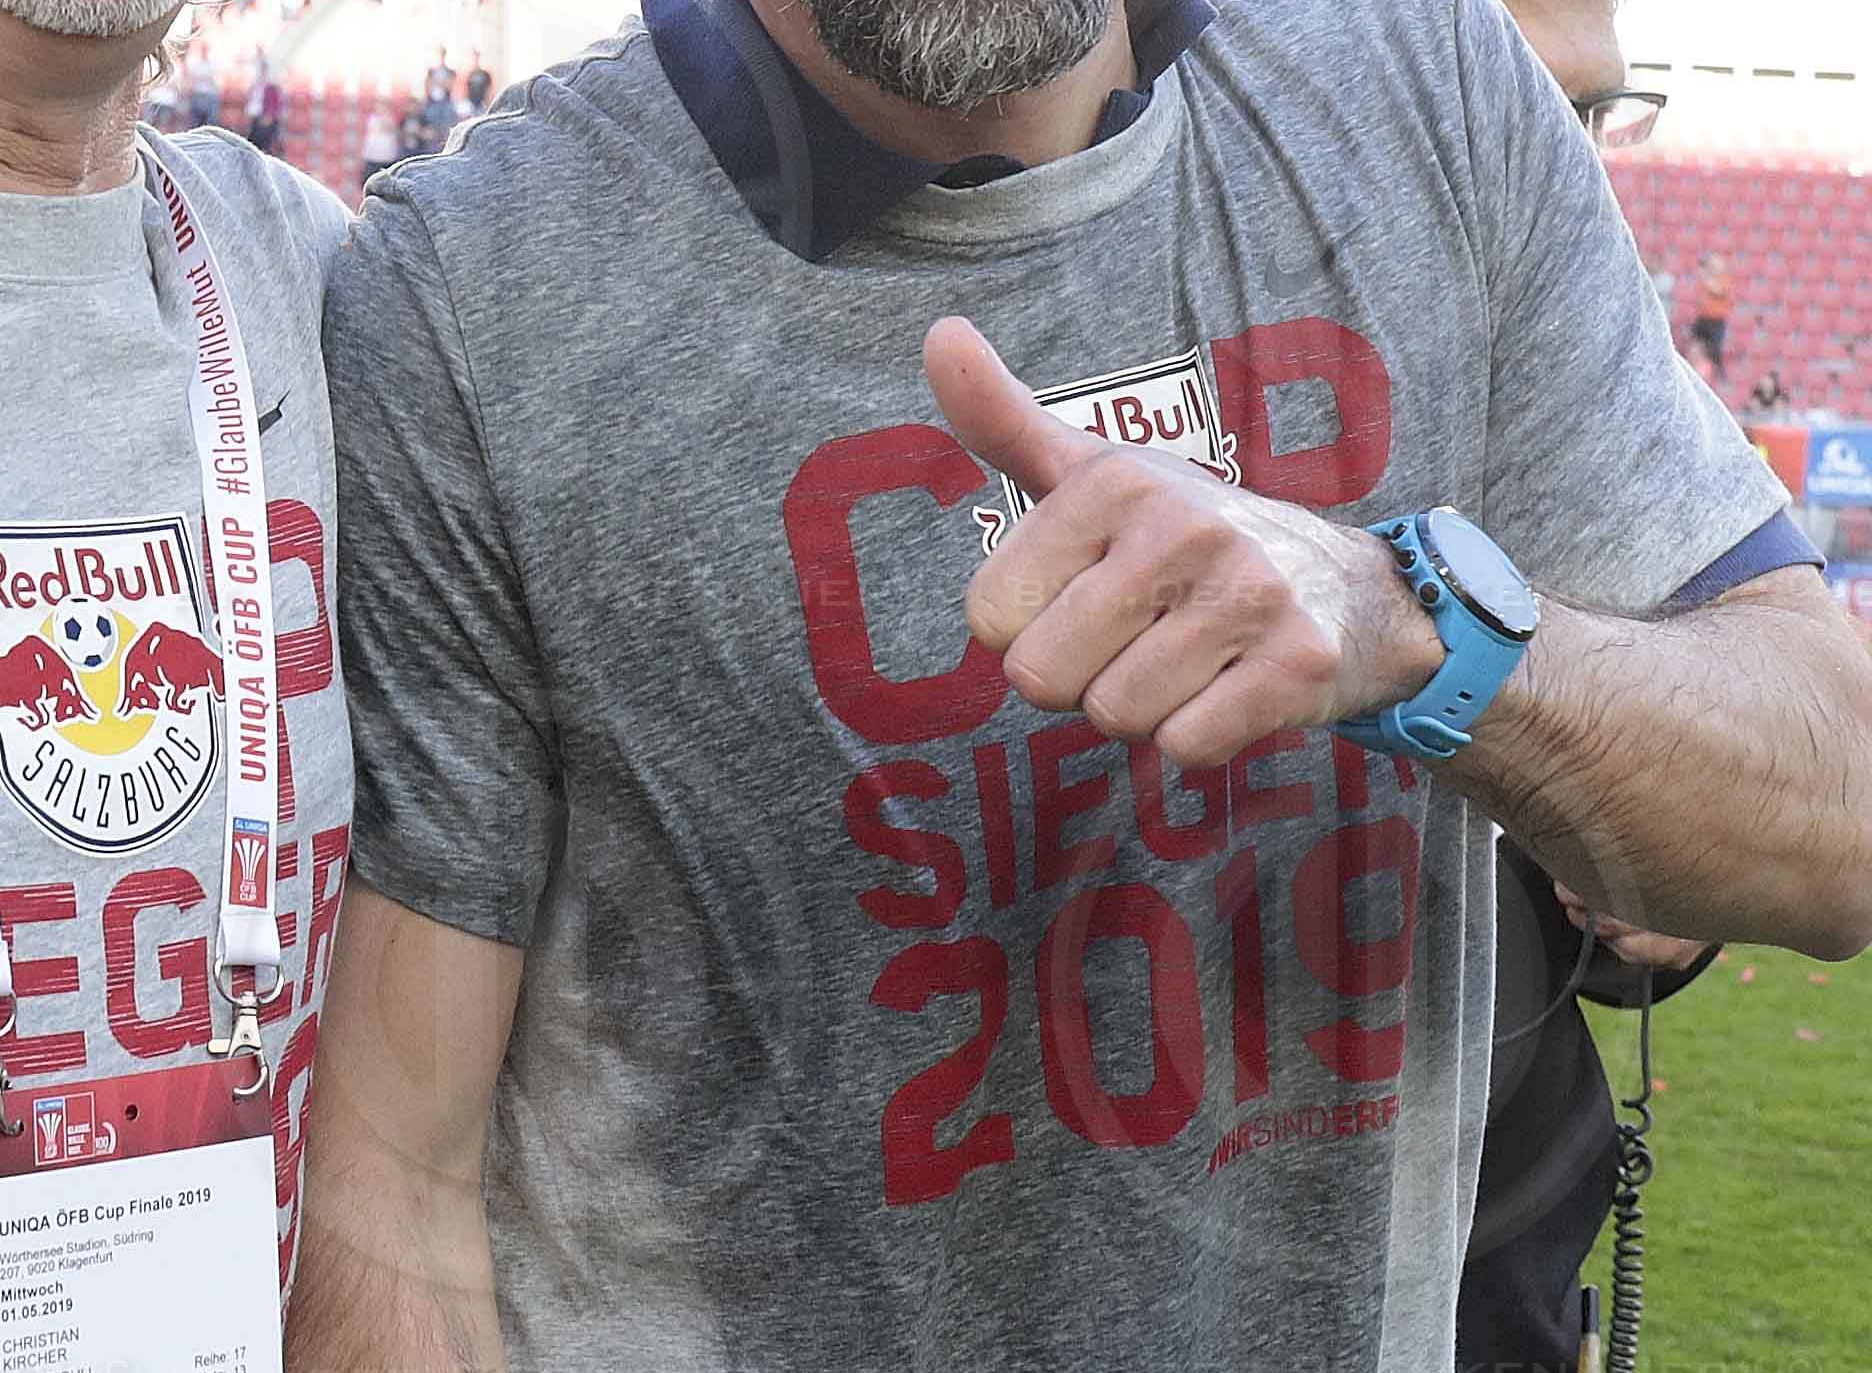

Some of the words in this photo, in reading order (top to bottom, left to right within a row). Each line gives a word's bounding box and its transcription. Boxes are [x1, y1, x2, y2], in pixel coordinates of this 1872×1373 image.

[186, 259, 250, 494] #GlaubeWilleMut
[223, 516, 258, 584] CUP
[229, 598, 264, 662] ÖFB
[239, 676, 270, 783] UNIQA
[22, 726, 201, 828] SALZBURG
[868, 816, 1422, 1207] 2019
[0, 1214, 51, 1237] UNIQA
[56, 1207, 90, 1228] ÖFB
[94, 1204, 125, 1223] Cup
[129, 1194, 174, 1216] Finale
[178, 1187, 212, 1207] 2019
[113, 1228, 155, 1246] Südring
[27, 1260, 56, 1276] 9020
[58, 1250, 114, 1271] Klagenfurt
[1, 1281, 64, 1303] Mittwoch
[1, 1298, 74, 1323] 01.05.2019
[2, 1327, 80, 1354] CHRISTIAN
[3, 1348, 68, 1371] KIRCHER
[234, 1346, 248, 1361] 17
